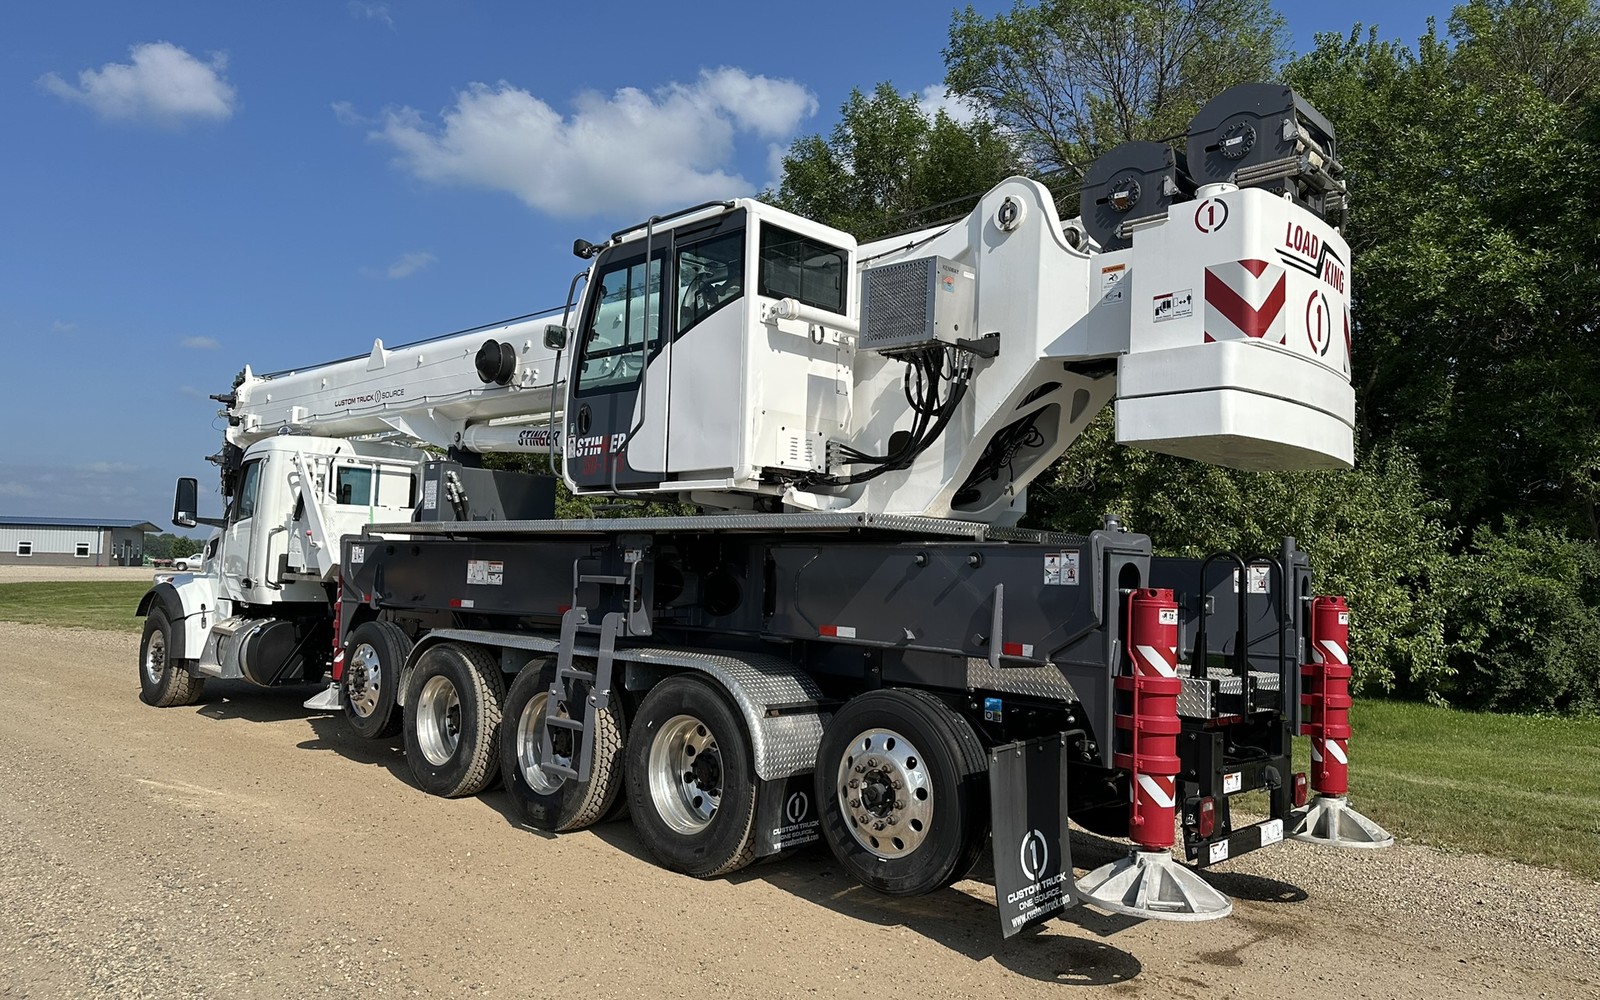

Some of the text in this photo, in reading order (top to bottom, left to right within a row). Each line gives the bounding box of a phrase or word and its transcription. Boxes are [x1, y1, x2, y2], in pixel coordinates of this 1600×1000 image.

[1285, 221, 1319, 260] LOAD
[1324, 258, 1345, 295] KING
[357, 394, 374, 403] TRUCK
[381, 388, 405, 399] SOURCE
[518, 430, 561, 446] STINGER
[576, 433, 627, 457] STINER
[773, 820, 819, 836] CUSTOM TRUCK
[1007, 871, 1067, 904] CUSTOM TRUCK
[1019, 887, 1060, 910] ONE SOURCE
